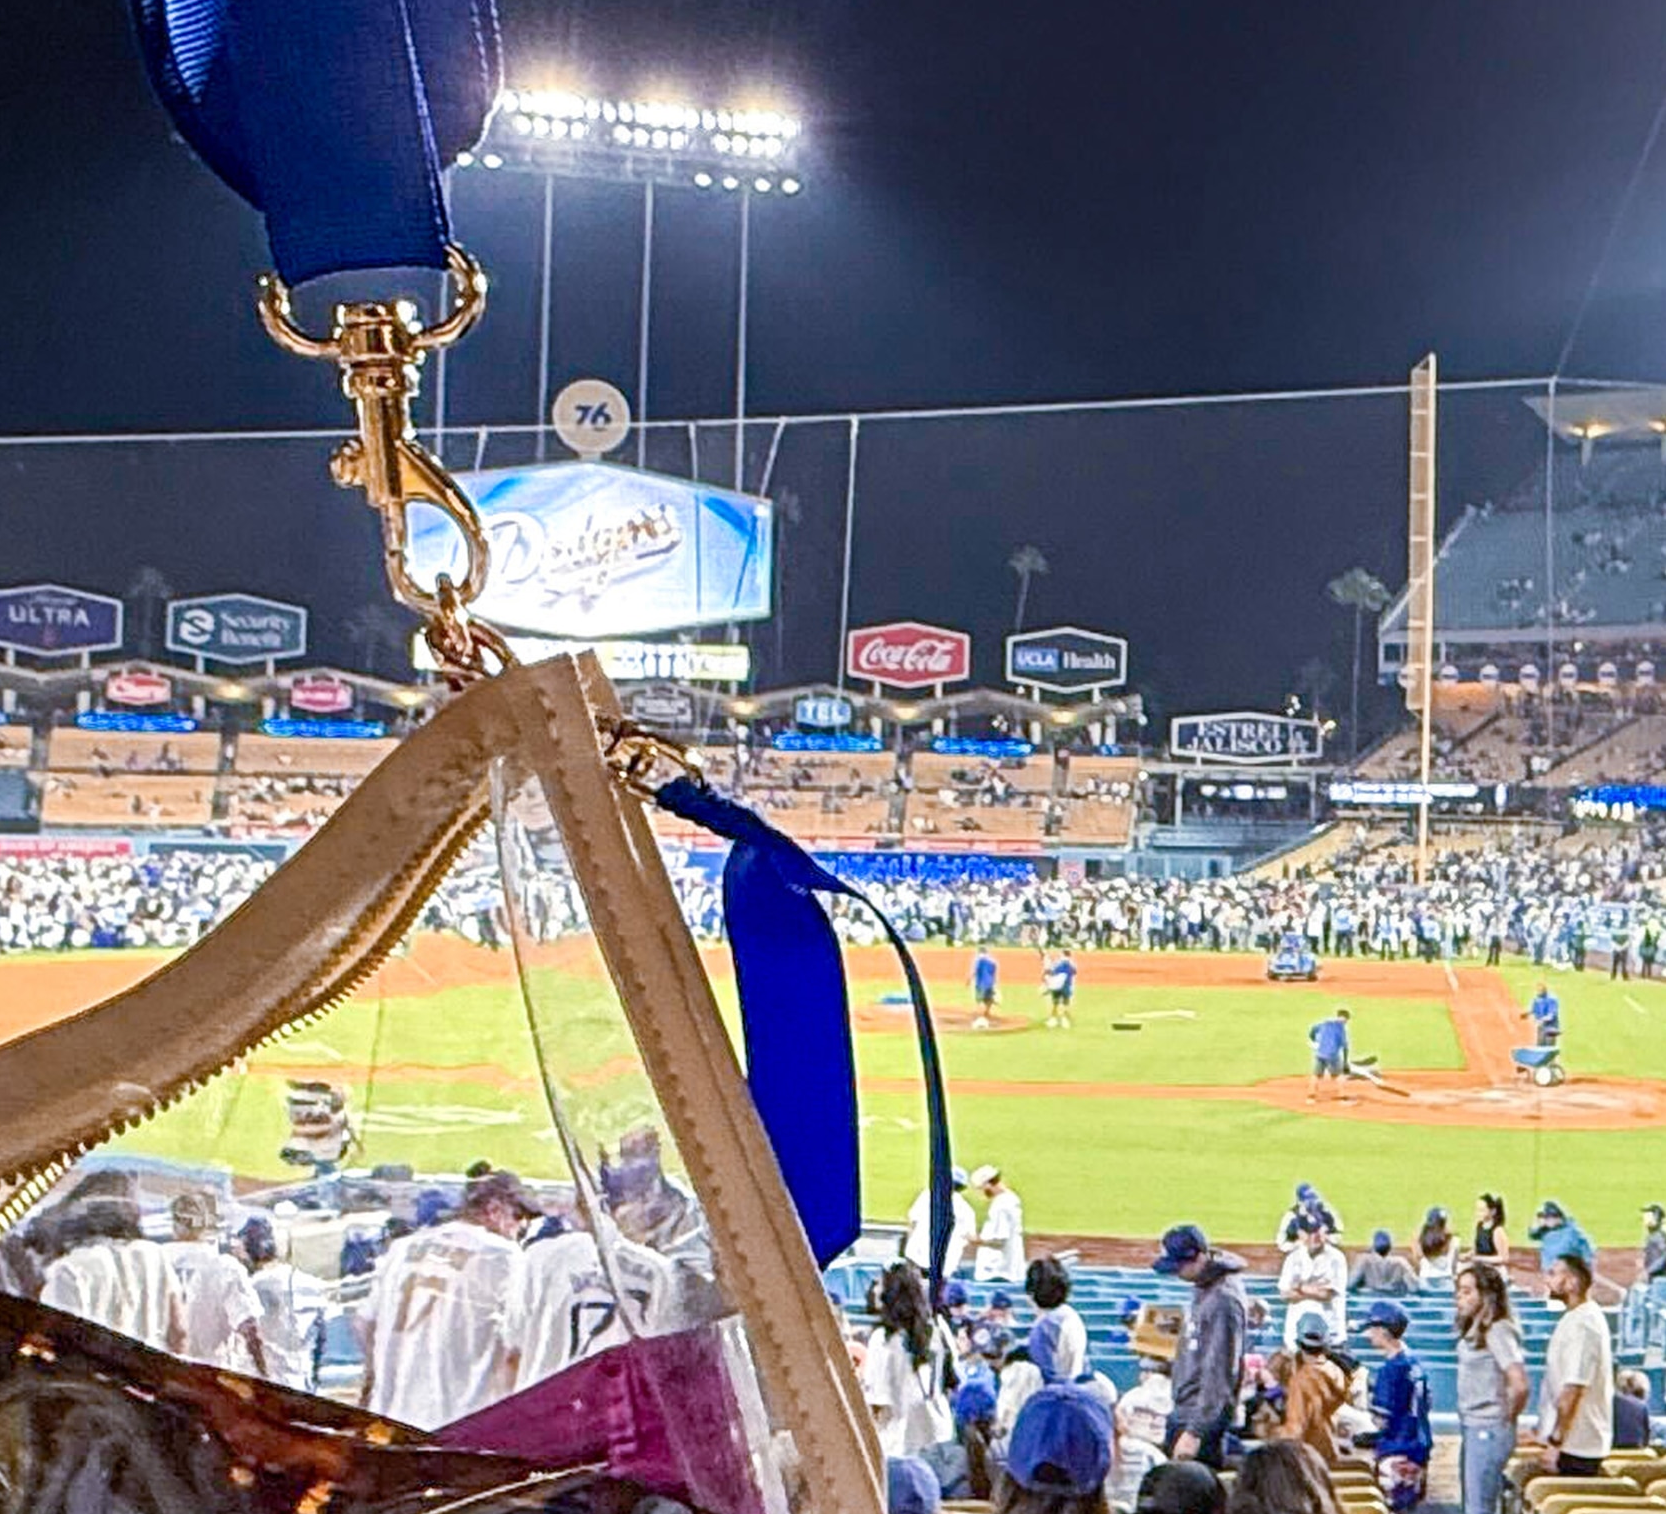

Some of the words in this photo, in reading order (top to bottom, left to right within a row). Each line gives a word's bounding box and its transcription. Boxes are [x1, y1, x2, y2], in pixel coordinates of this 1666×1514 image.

[574, 402, 612, 431] 76
[9, 604, 90, 628] ULTRA
[219, 611, 291, 634] Security
[1016, 651, 1055, 671] UCLA
[1062, 650, 1116, 671] Health
[1187, 736, 1282, 754] JALISCO
